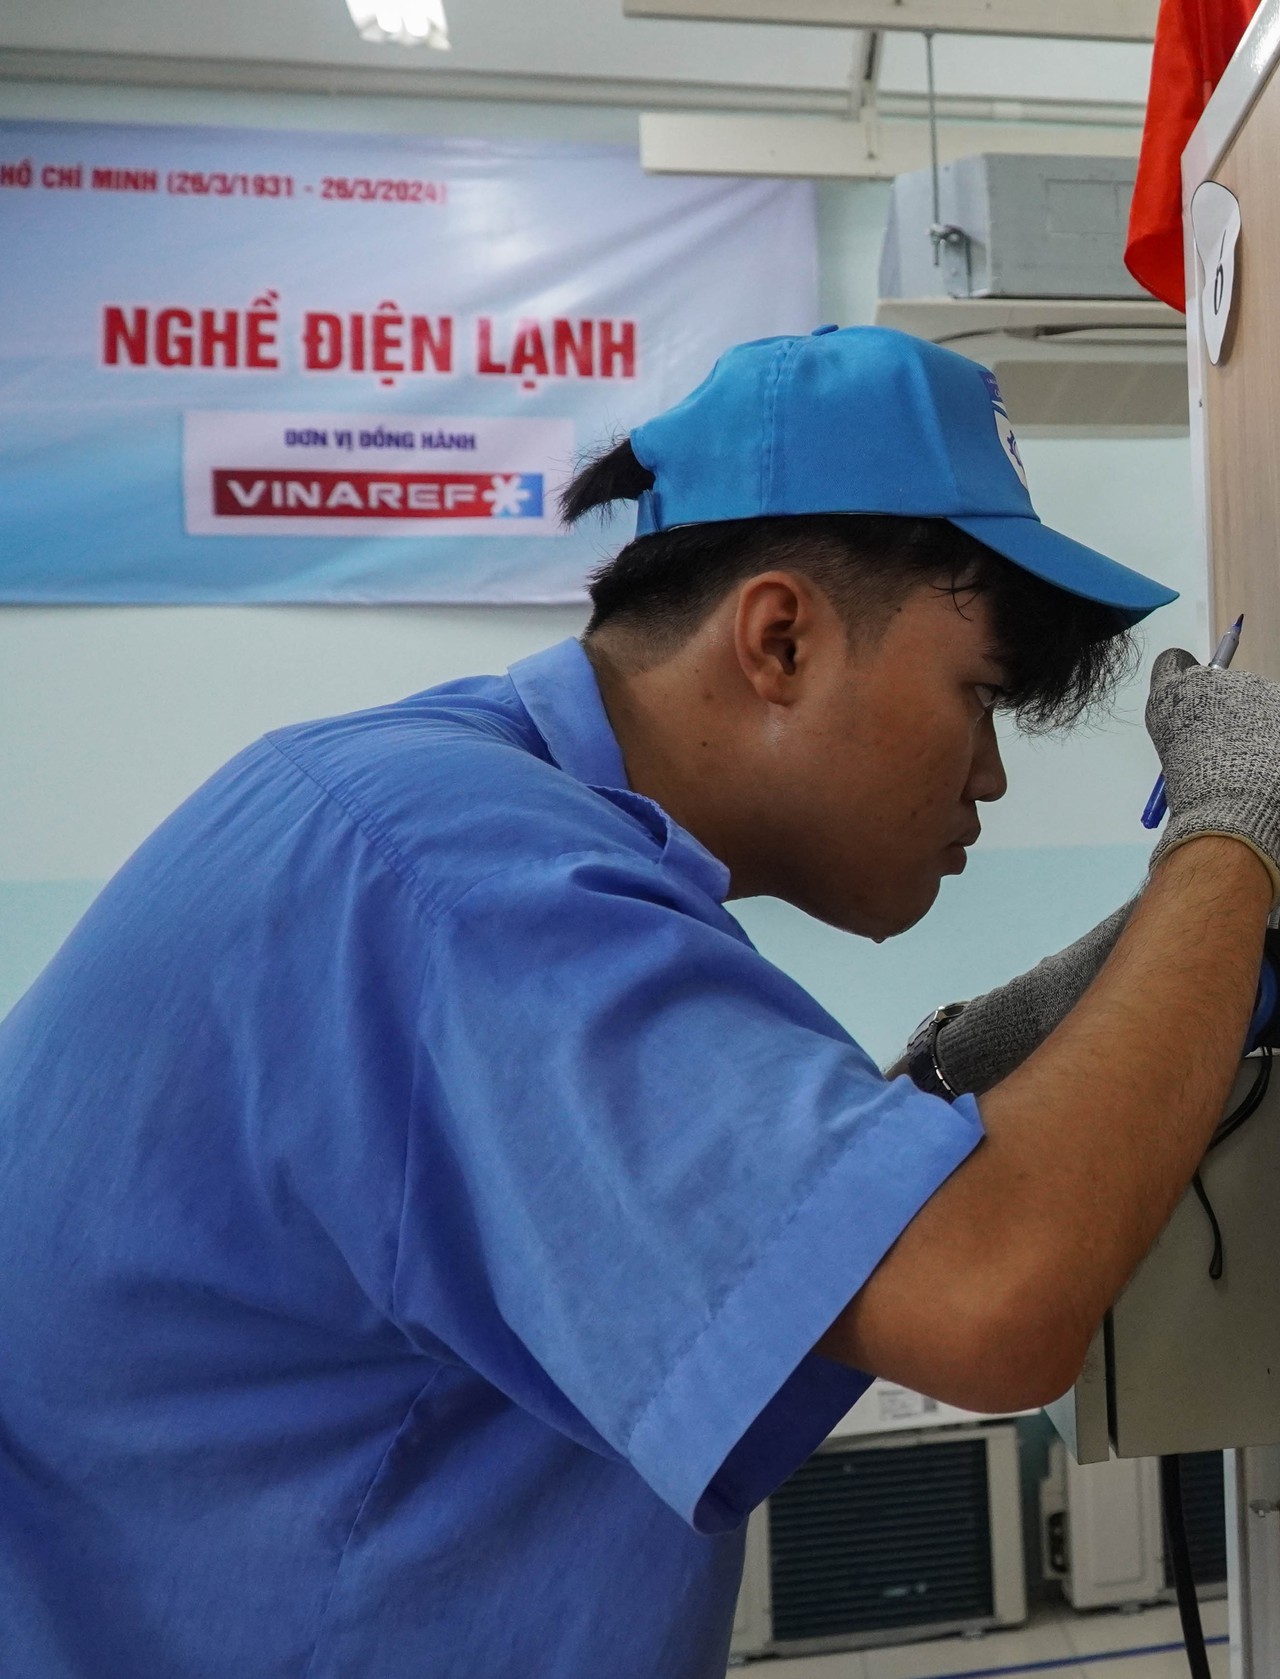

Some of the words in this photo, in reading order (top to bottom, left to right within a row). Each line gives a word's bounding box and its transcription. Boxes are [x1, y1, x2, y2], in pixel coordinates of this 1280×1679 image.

[91, 168, 158, 192] MINH
[103, 288, 279, 369] NGHỀ
[302, 301, 453, 386] ĐIỆN
[477, 317, 636, 389] LẠNH
[227, 480, 478, 509] VINAREF
